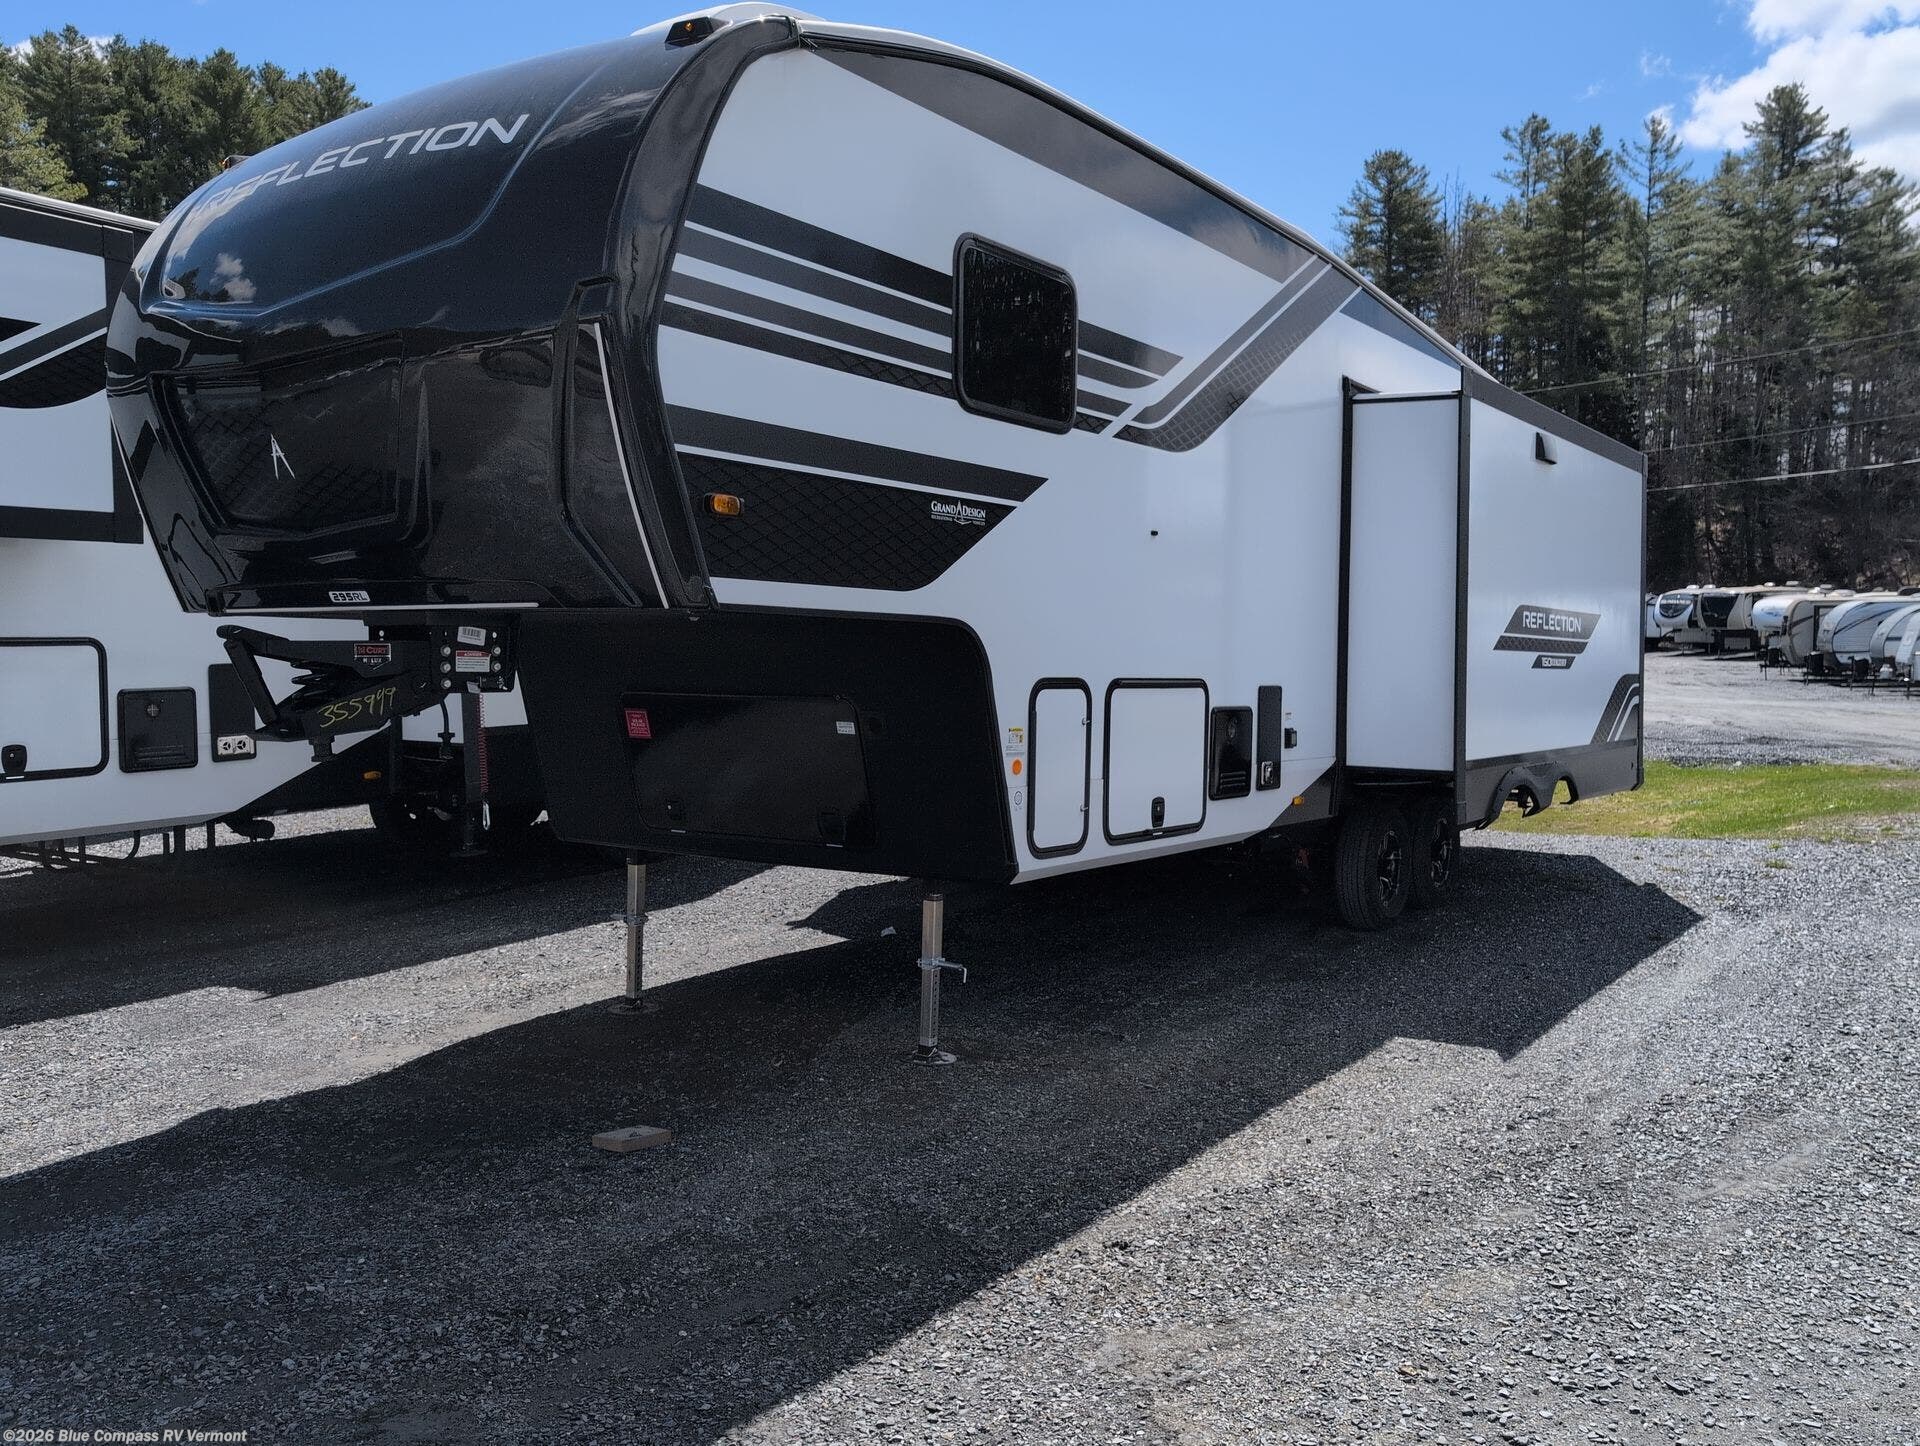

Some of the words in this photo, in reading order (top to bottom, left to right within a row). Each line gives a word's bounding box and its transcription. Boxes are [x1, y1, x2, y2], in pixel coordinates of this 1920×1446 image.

[196, 113, 530, 216] REFLECTION
[930, 500, 957, 515] GRAND
[962, 505, 986, 518] DESIGN
[331, 592, 369, 601] 295RL
[1522, 611, 1581, 632] REFLECTION
